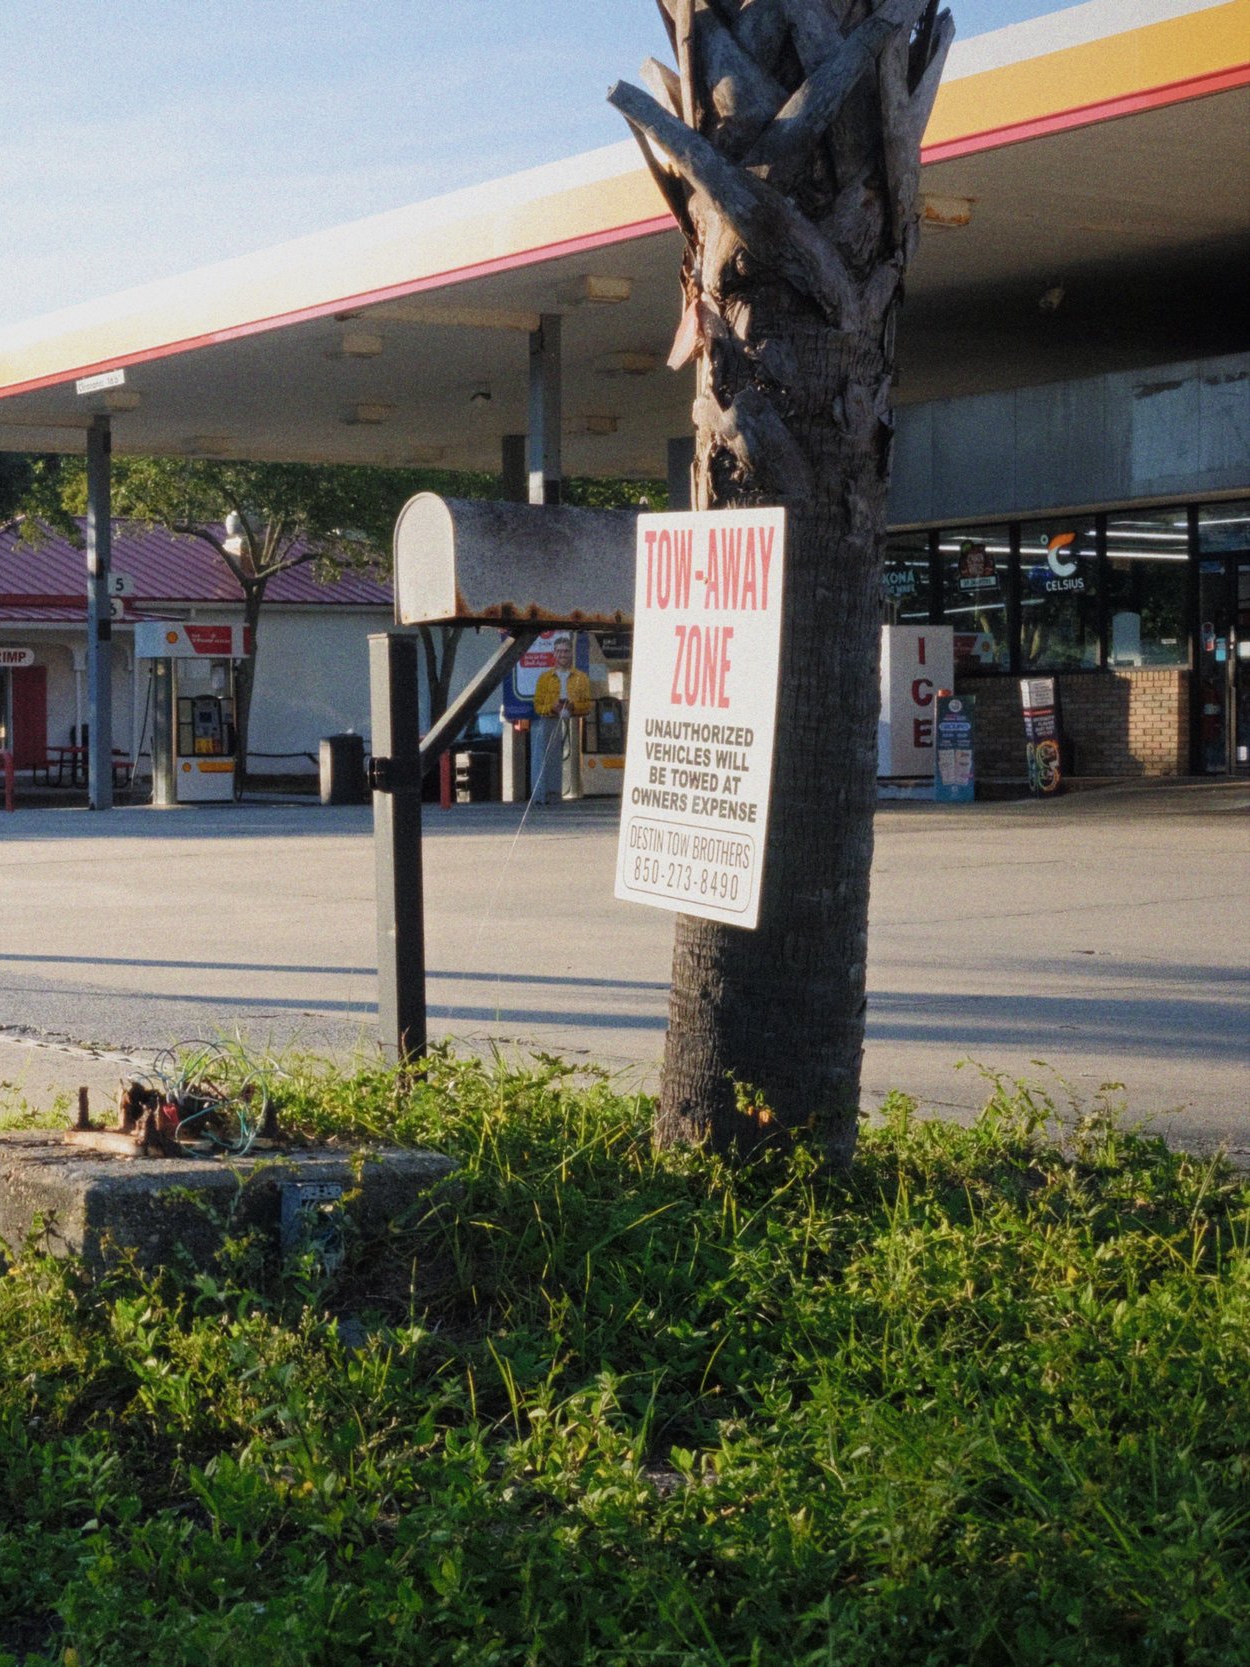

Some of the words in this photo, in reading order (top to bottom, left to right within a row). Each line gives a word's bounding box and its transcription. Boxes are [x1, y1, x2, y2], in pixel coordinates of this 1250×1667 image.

[115, 578, 124, 591] 5
[1046, 578, 1085, 592] CELSIUS
[671, 625, 734, 708] ZONE
[912, 637, 934, 748] ICE
[645, 718, 754, 747] UNAUTHORIZED
[645, 742, 711, 768] VEHICLES
[715, 749, 750, 772] WILL
[649, 765, 667, 785] BE
[671, 768, 719, 793] TOWED
[722, 775, 741, 795] AT
[631, 787, 688, 812] OWNERS
[691, 795, 757, 823] EXPENSE
[630, 824, 664, 853] DESTIN
[667, 831, 690, 858] TOW
[692, 836, 750, 869] BROTHERS
[634, 856, 739, 901] 850-273-8490
